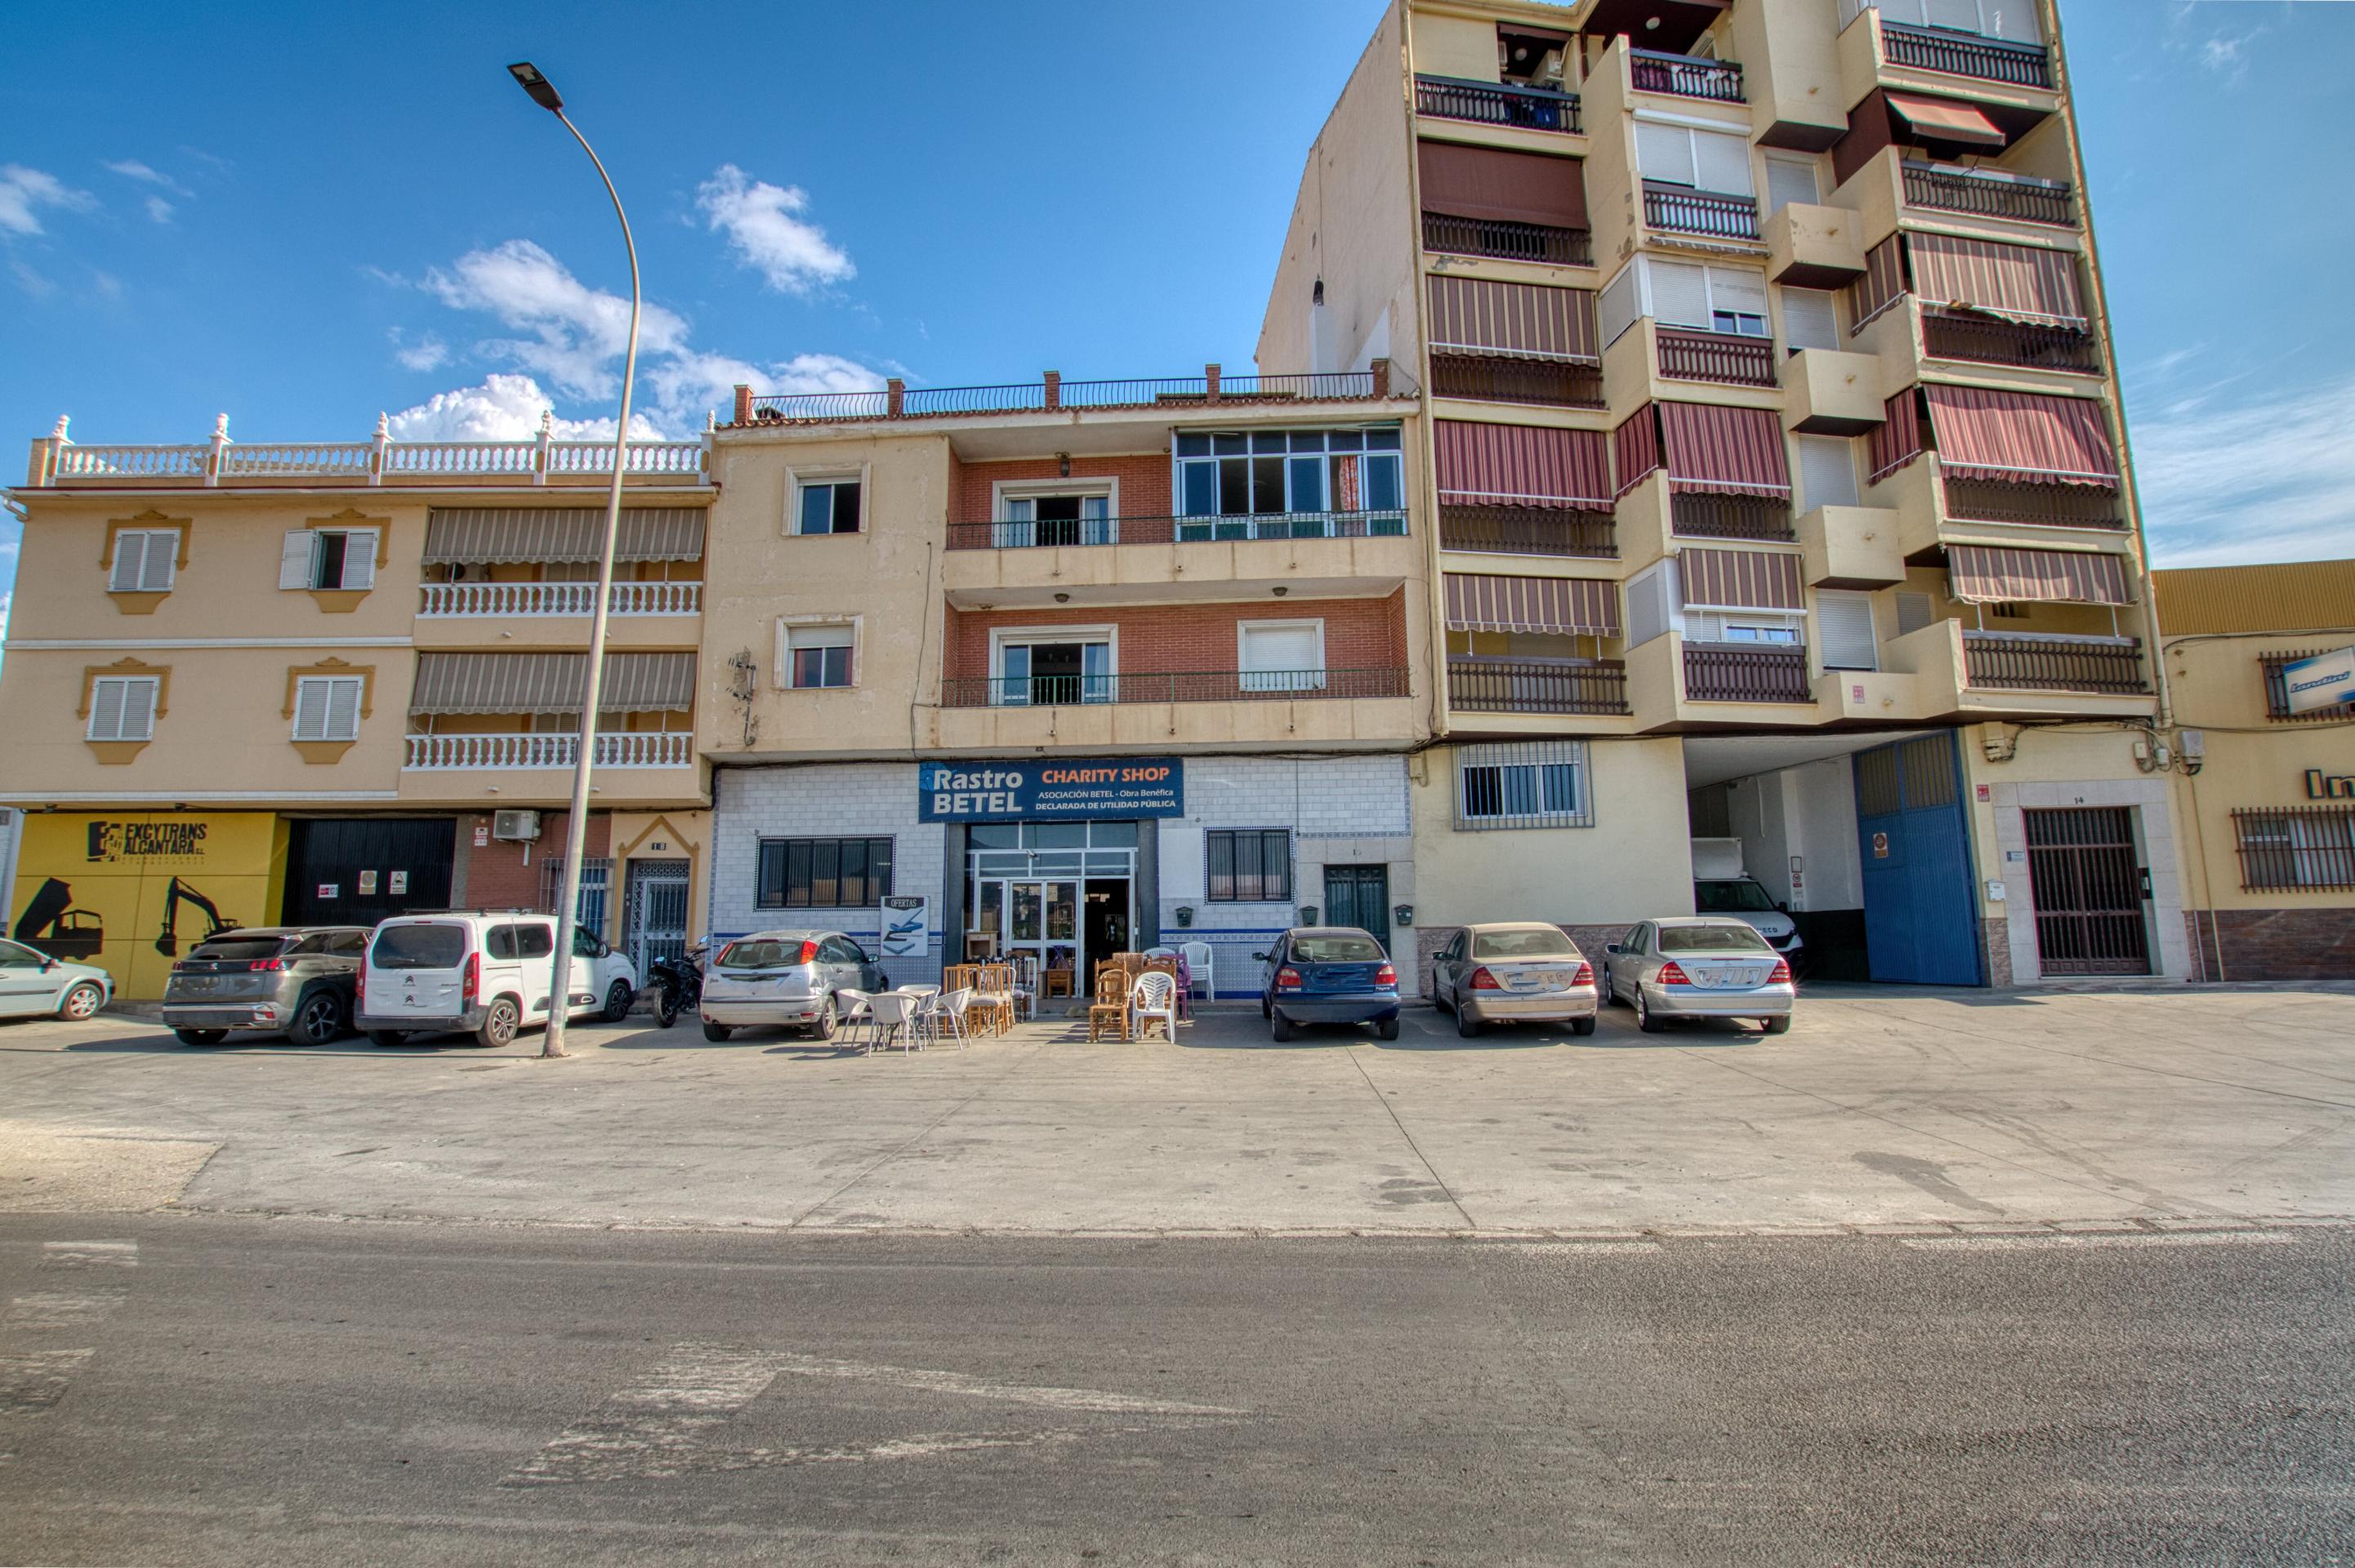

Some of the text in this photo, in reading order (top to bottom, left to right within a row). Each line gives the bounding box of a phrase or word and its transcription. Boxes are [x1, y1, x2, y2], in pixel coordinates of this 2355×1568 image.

[934, 769, 1024, 790] Rastro
[1041, 767, 1171, 784] CHARITY SHOP
[934, 791, 1023, 813] BETEL
[1038, 790, 1089, 799] ASOCIACIÓN
[1090, 790, 1114, 798] BETEL
[1119, 789, 1140, 797] Obra
[1035, 802, 1086, 810] DECLARADA
[1100, 800, 1140, 808] UTILIDAD
[1140, 800, 1176, 808] PÚBLICA
[126, 823, 207, 840] EXCYTRANS
[123, 838, 194, 854] ALCANTARA
[891, 898, 917, 907] OFERTAS
